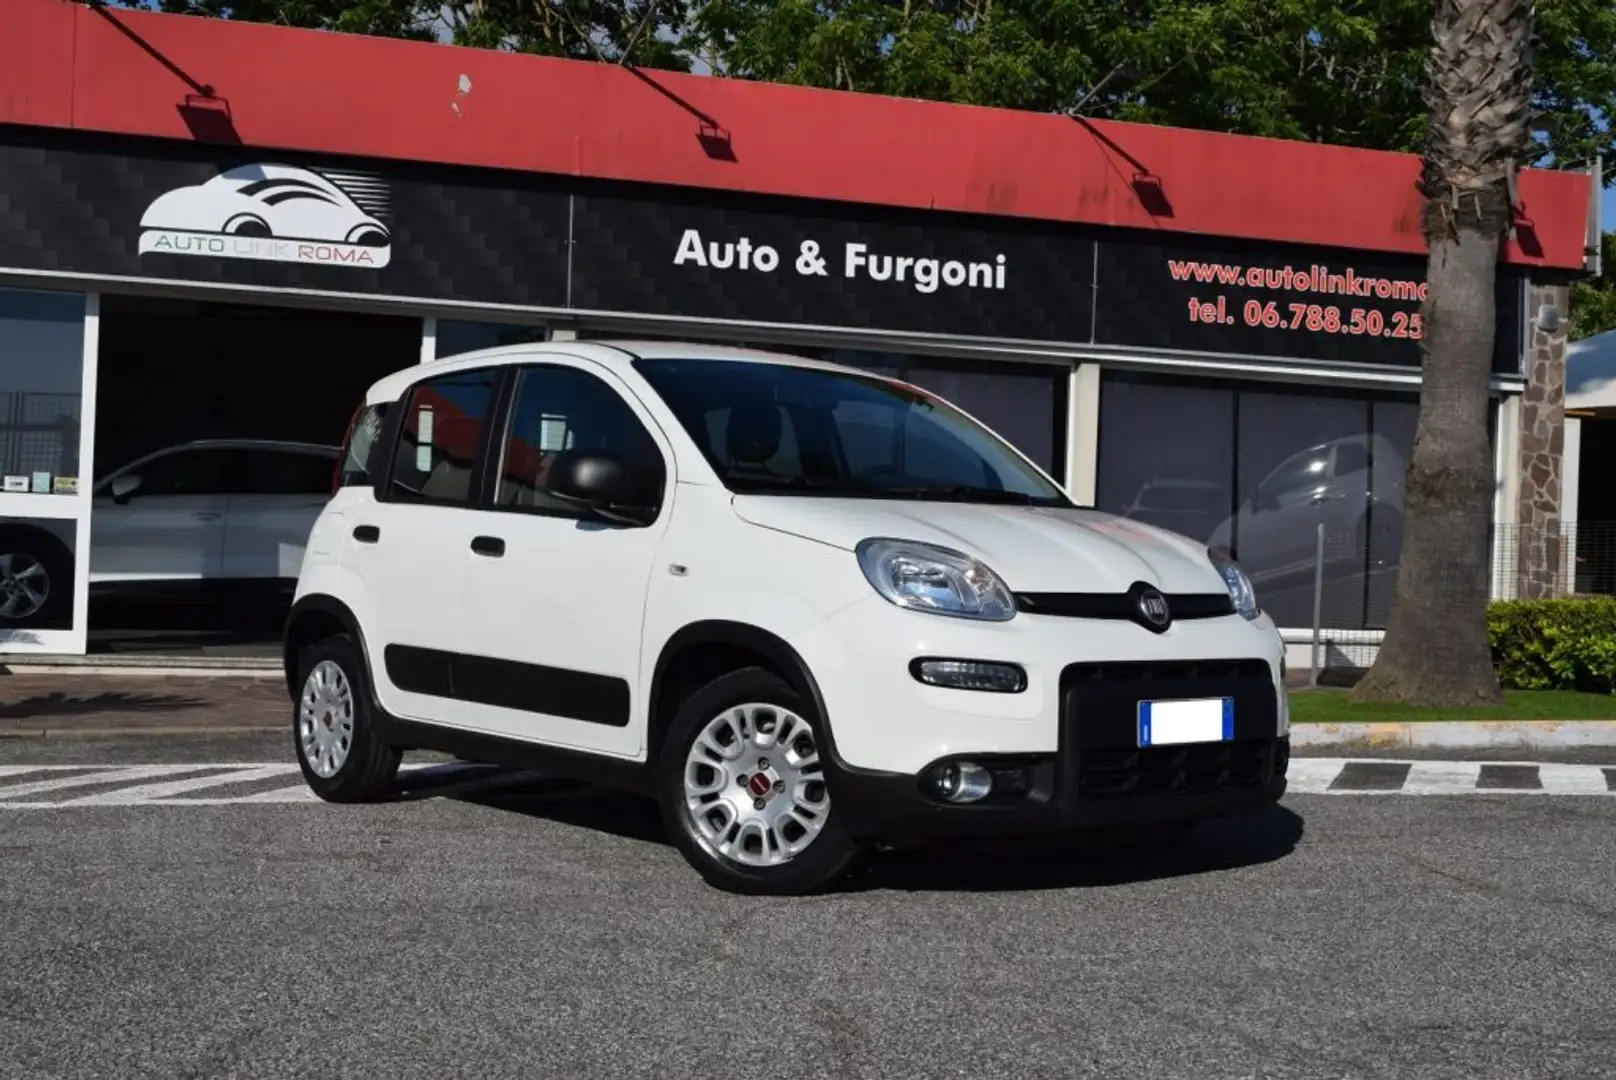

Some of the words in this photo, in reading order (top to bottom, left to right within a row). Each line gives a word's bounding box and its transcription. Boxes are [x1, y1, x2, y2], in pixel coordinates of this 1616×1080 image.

[154, 235, 225, 252] AUTO
[232, 240, 291, 256] LINK
[297, 244, 375, 264] ROMA
[673, 229, 779, 272] Auto
[795, 239, 829, 276] &
[845, 243, 1007, 293] Furgoni
[1188, 296, 1234, 325] tel.
[1244, 300, 1425, 339] 06.788.50.25
